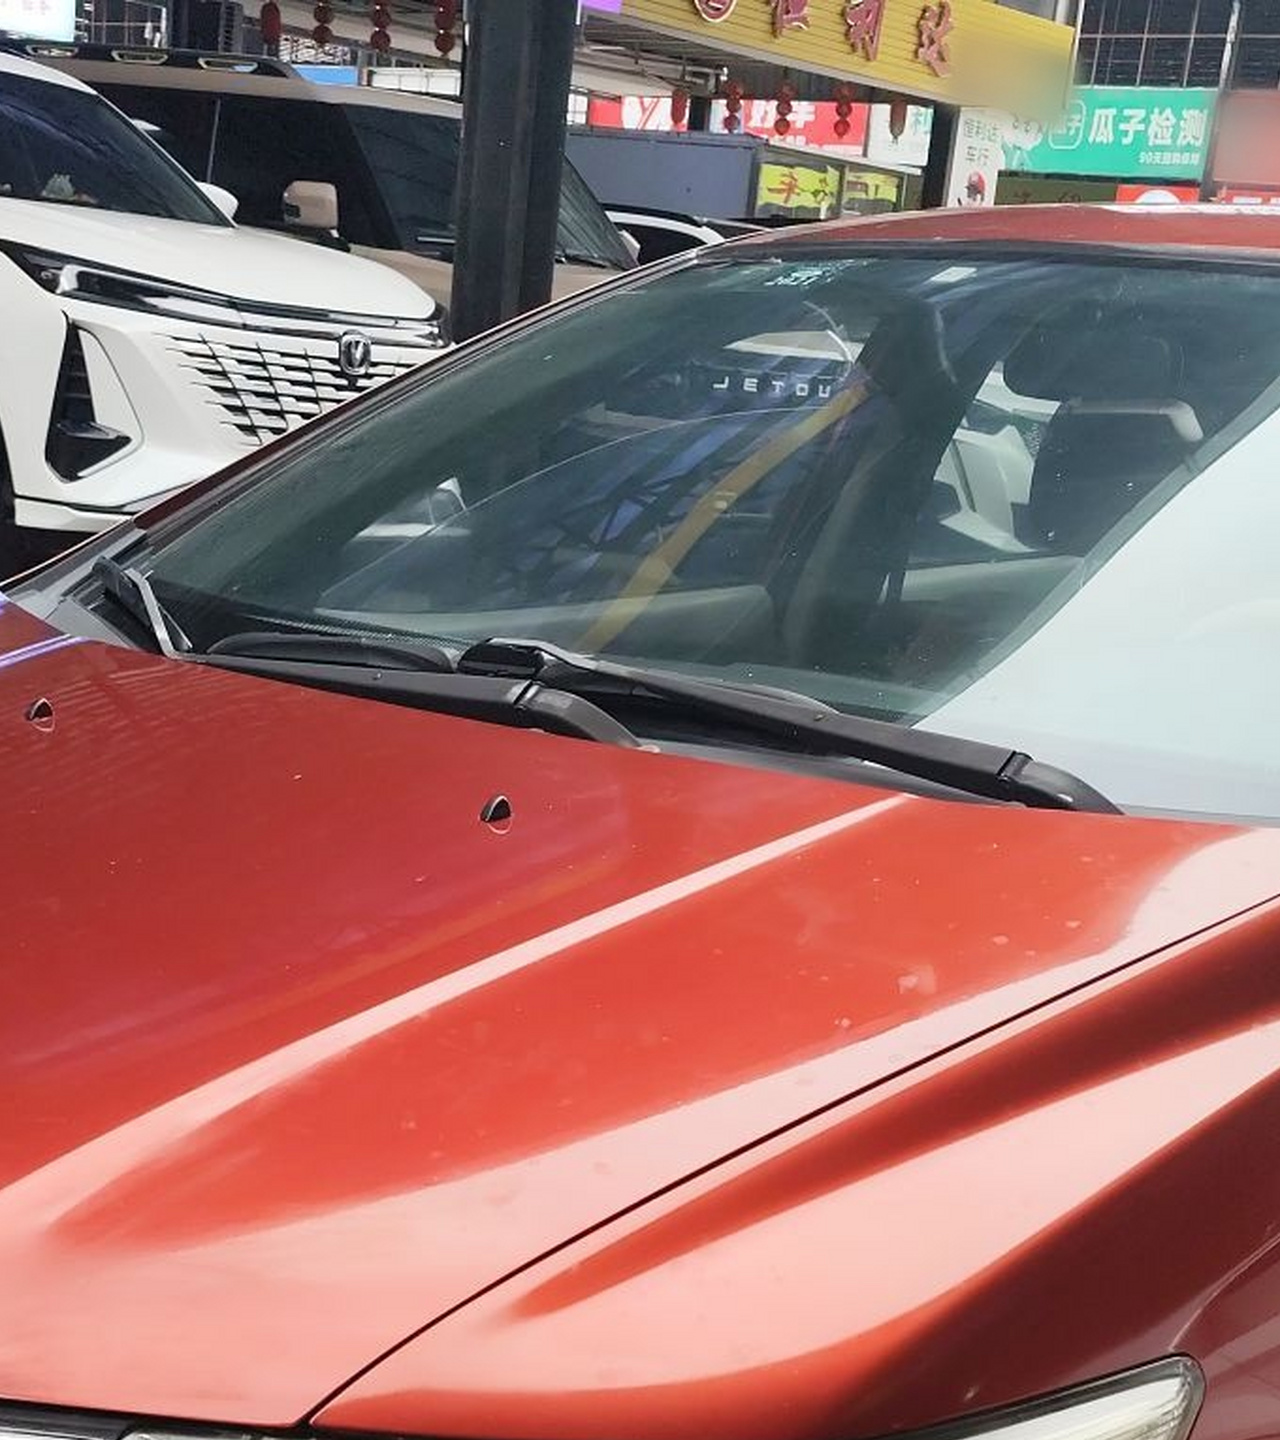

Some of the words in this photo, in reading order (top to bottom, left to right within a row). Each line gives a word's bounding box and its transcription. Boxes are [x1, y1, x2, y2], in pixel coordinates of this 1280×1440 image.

[1088, 107, 1208, 148] 瓜子检测
[713, 376, 832, 398] JETOU
